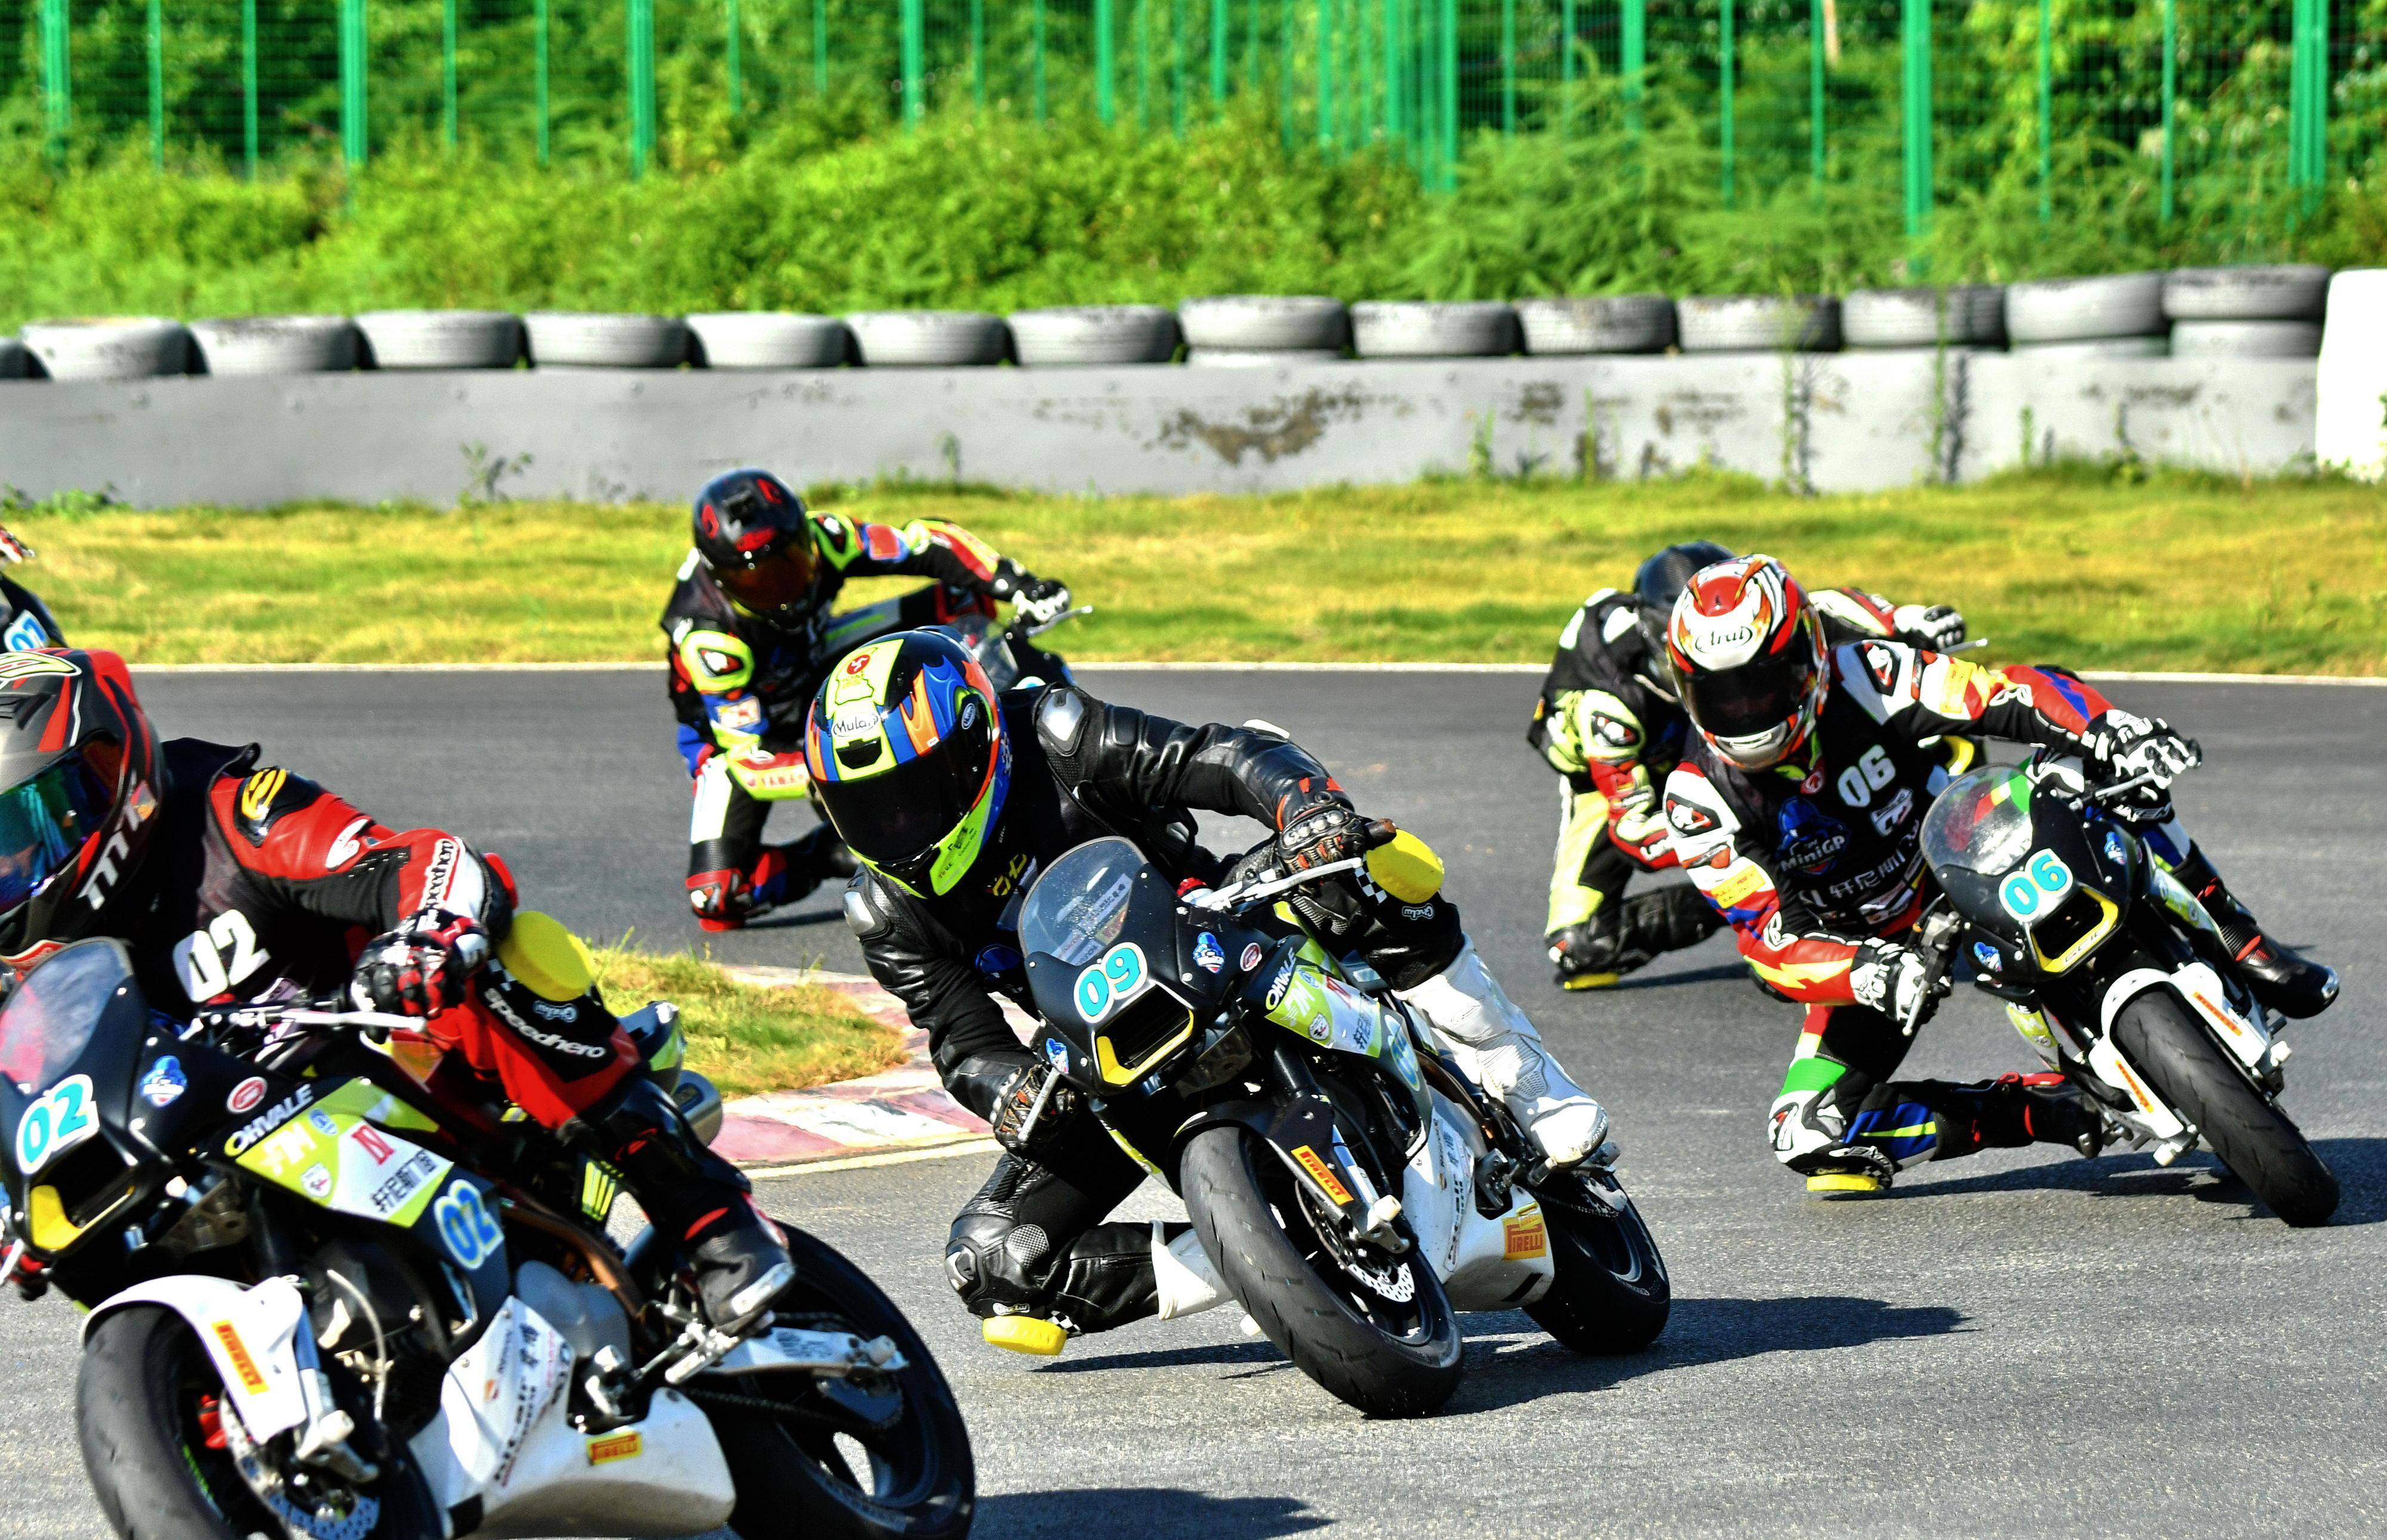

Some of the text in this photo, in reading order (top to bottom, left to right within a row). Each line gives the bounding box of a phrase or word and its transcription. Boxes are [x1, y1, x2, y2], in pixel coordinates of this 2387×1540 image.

[1837, 744, 1896, 807] 06
[2004, 853, 2068, 915] 06
[174, 909, 270, 1003] 02
[1078, 948, 1141, 1017] 09
[1265, 947, 1296, 1010] OHVALE
[484, 987, 606, 1058] speedhero
[23, 1083, 89, 1163] 02
[224, 1083, 314, 1157] OHVALE
[1299, 1150, 1346, 1196] PIRELLI
[442, 1186, 497, 1261] 02
[1506, 1223, 1544, 1254] PIRELLI
